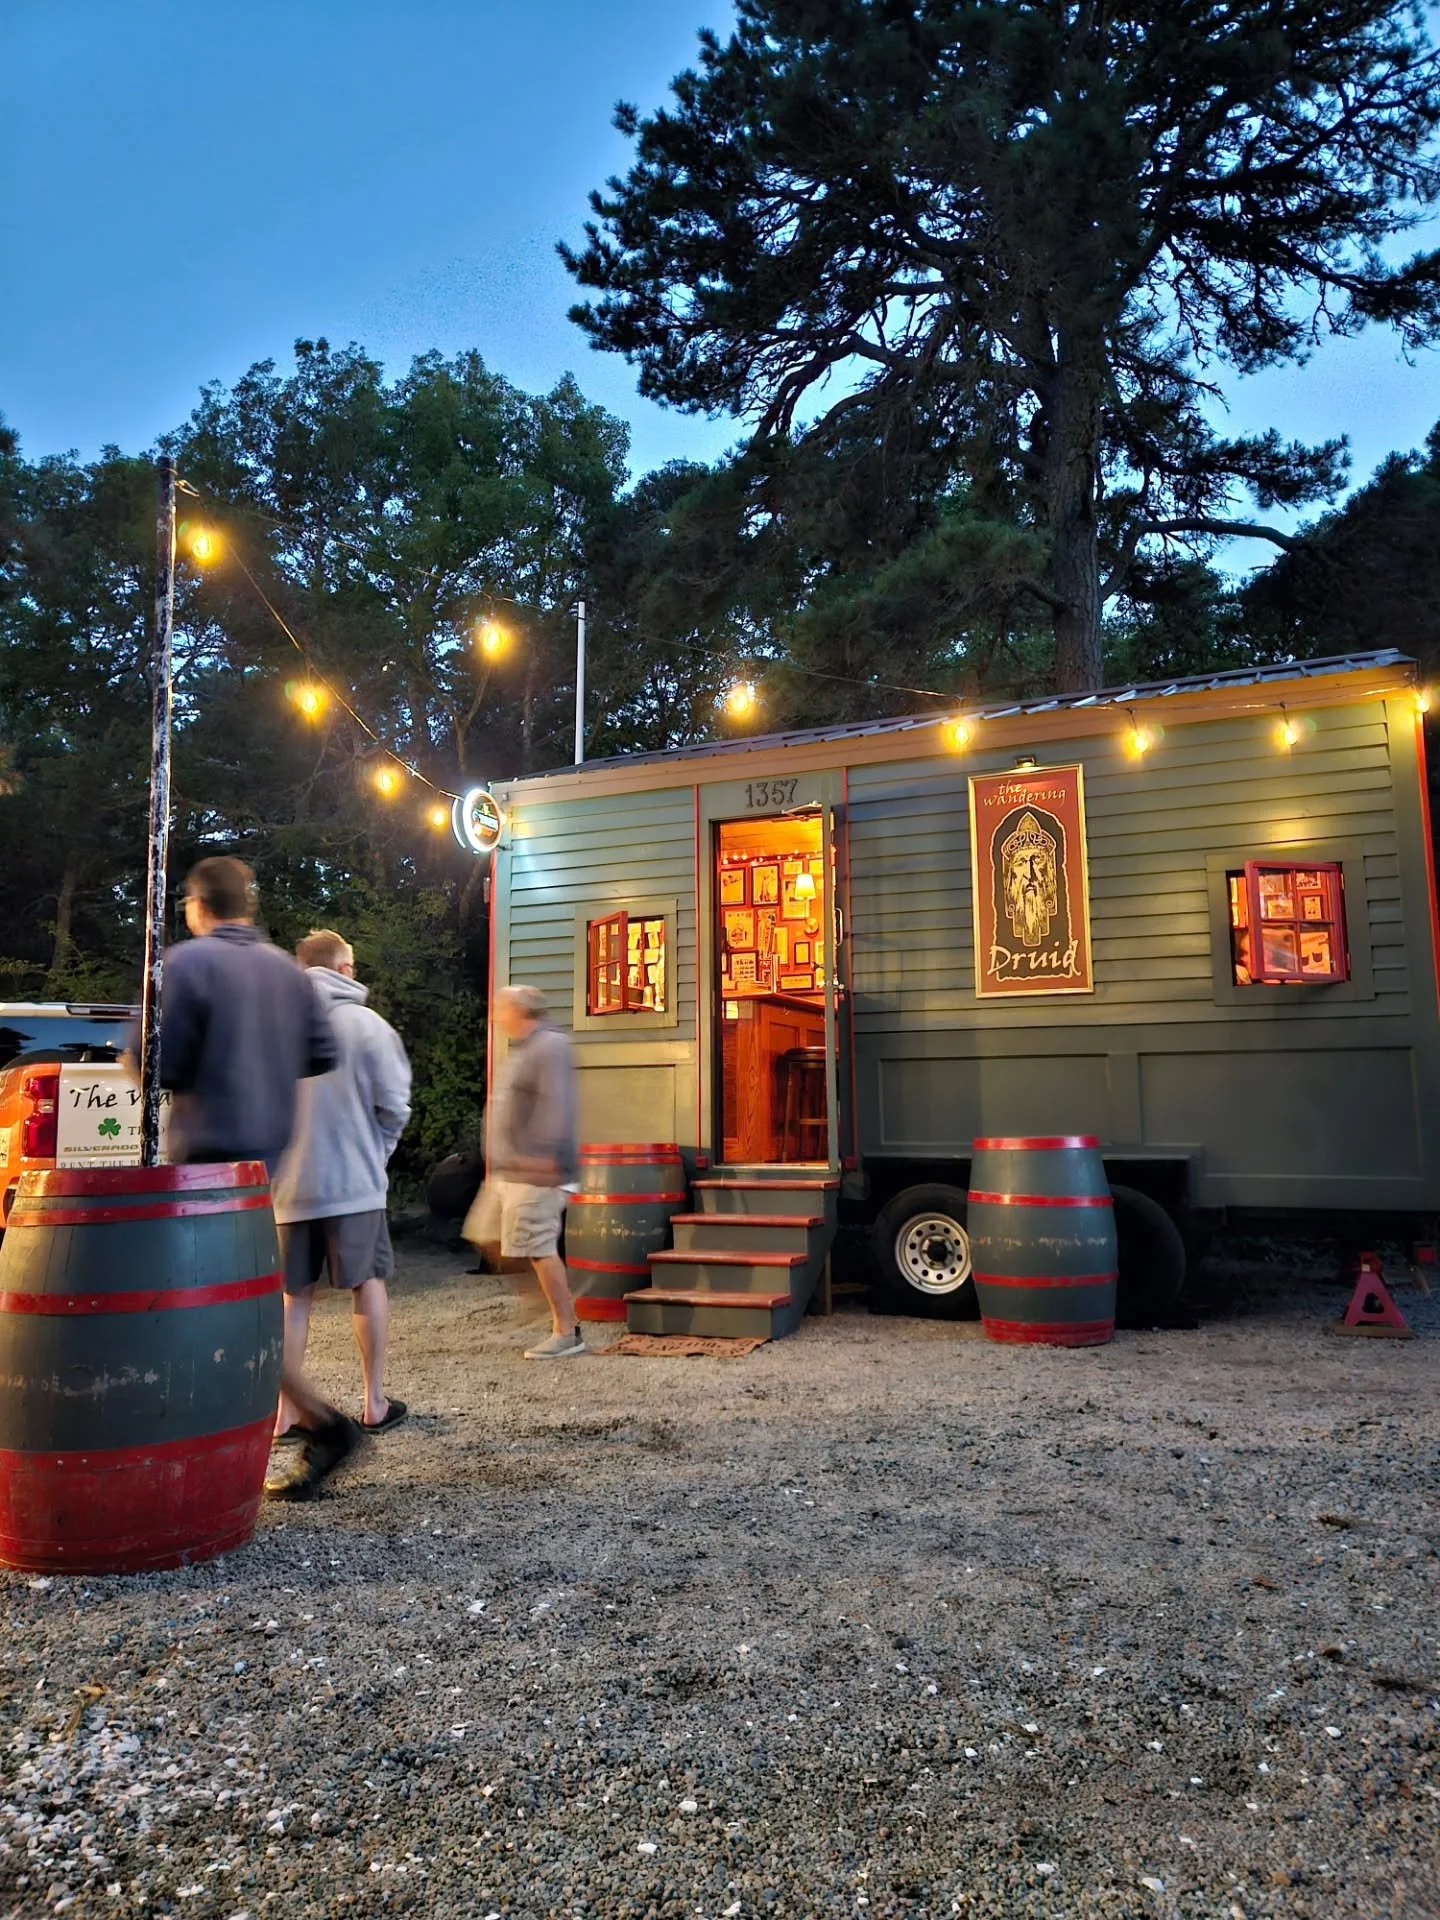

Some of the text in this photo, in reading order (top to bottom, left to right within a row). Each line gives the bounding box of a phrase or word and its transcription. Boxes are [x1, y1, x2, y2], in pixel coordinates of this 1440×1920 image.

[745, 779, 798, 808] 1357
[983, 787, 1066, 807] wandering
[998, 780, 1022, 795] the
[986, 939, 1081, 975] Druid
[70, 1084, 118, 1108] The
[63, 1144, 139, 1153] SILVERADO
